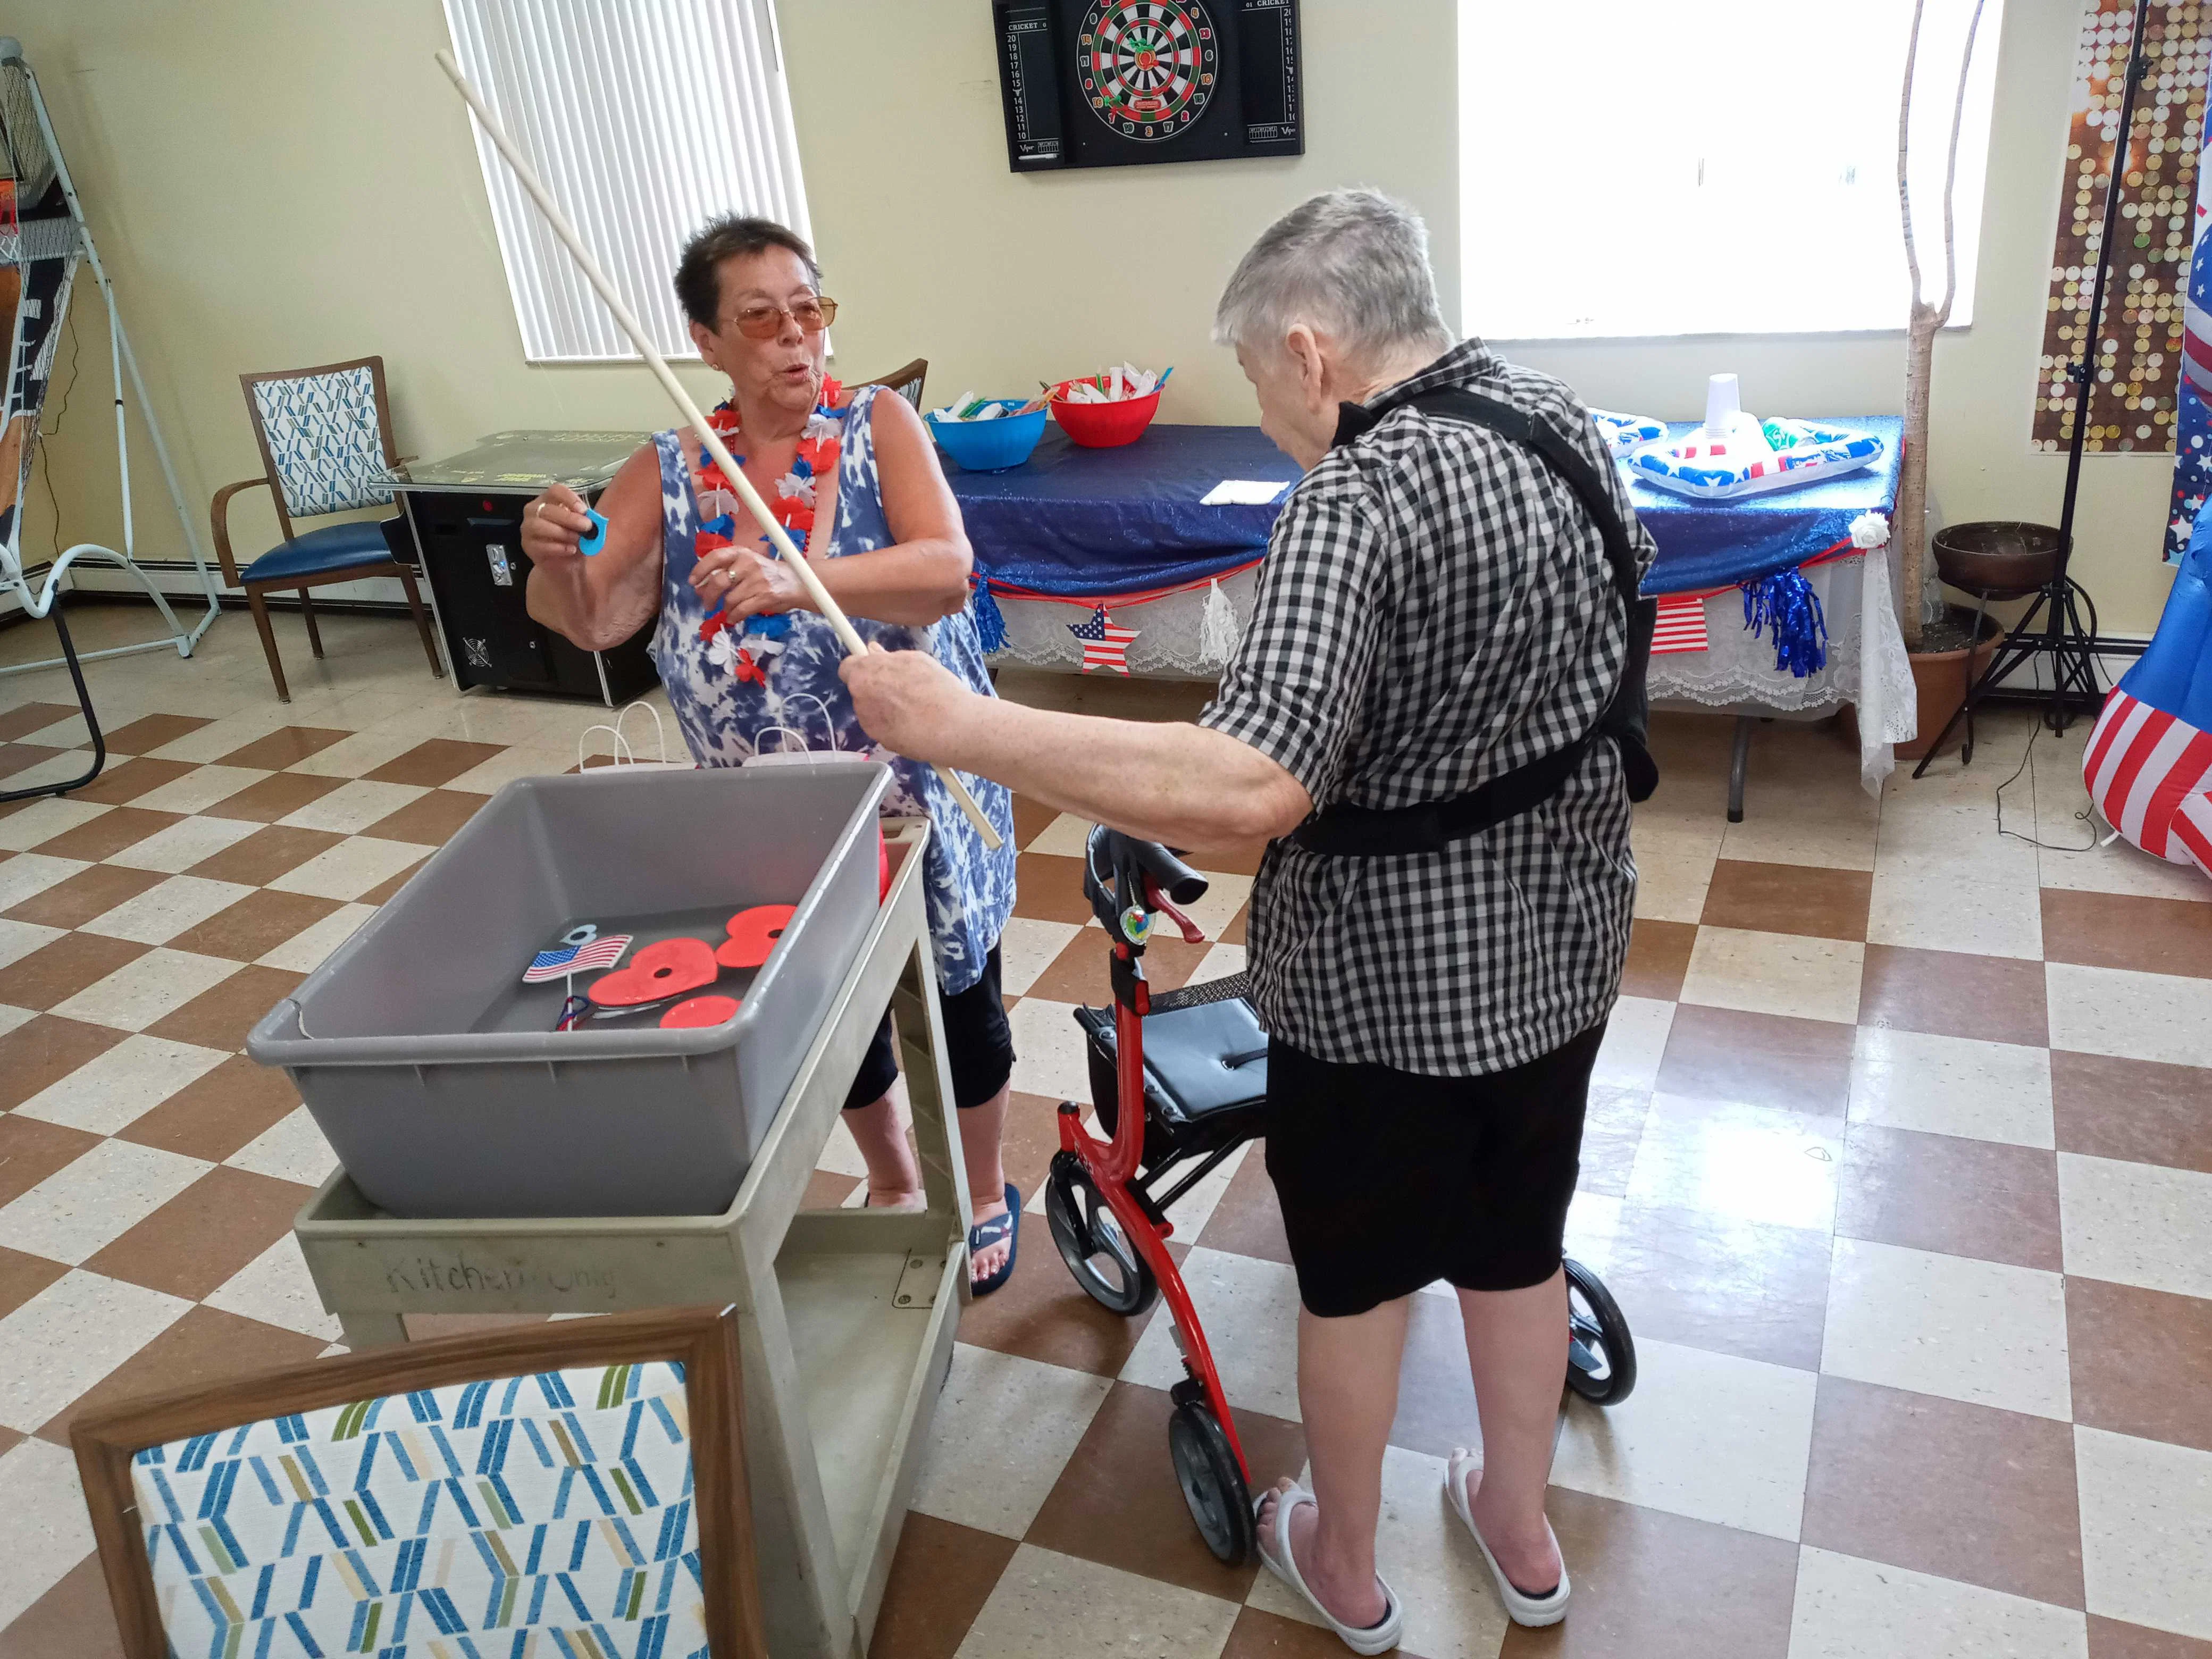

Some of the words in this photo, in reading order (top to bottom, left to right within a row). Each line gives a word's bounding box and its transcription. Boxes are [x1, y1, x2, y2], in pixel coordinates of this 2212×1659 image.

[1008, 22, 1038, 31] CRICKET
[1201, 73, 1213, 85] 10
[1092, 97, 1103, 108] 16
[1181, 110, 1189, 122] 2
[1145, 125, 1153, 137] 3
[1019, 144, 1034, 153] Viper
